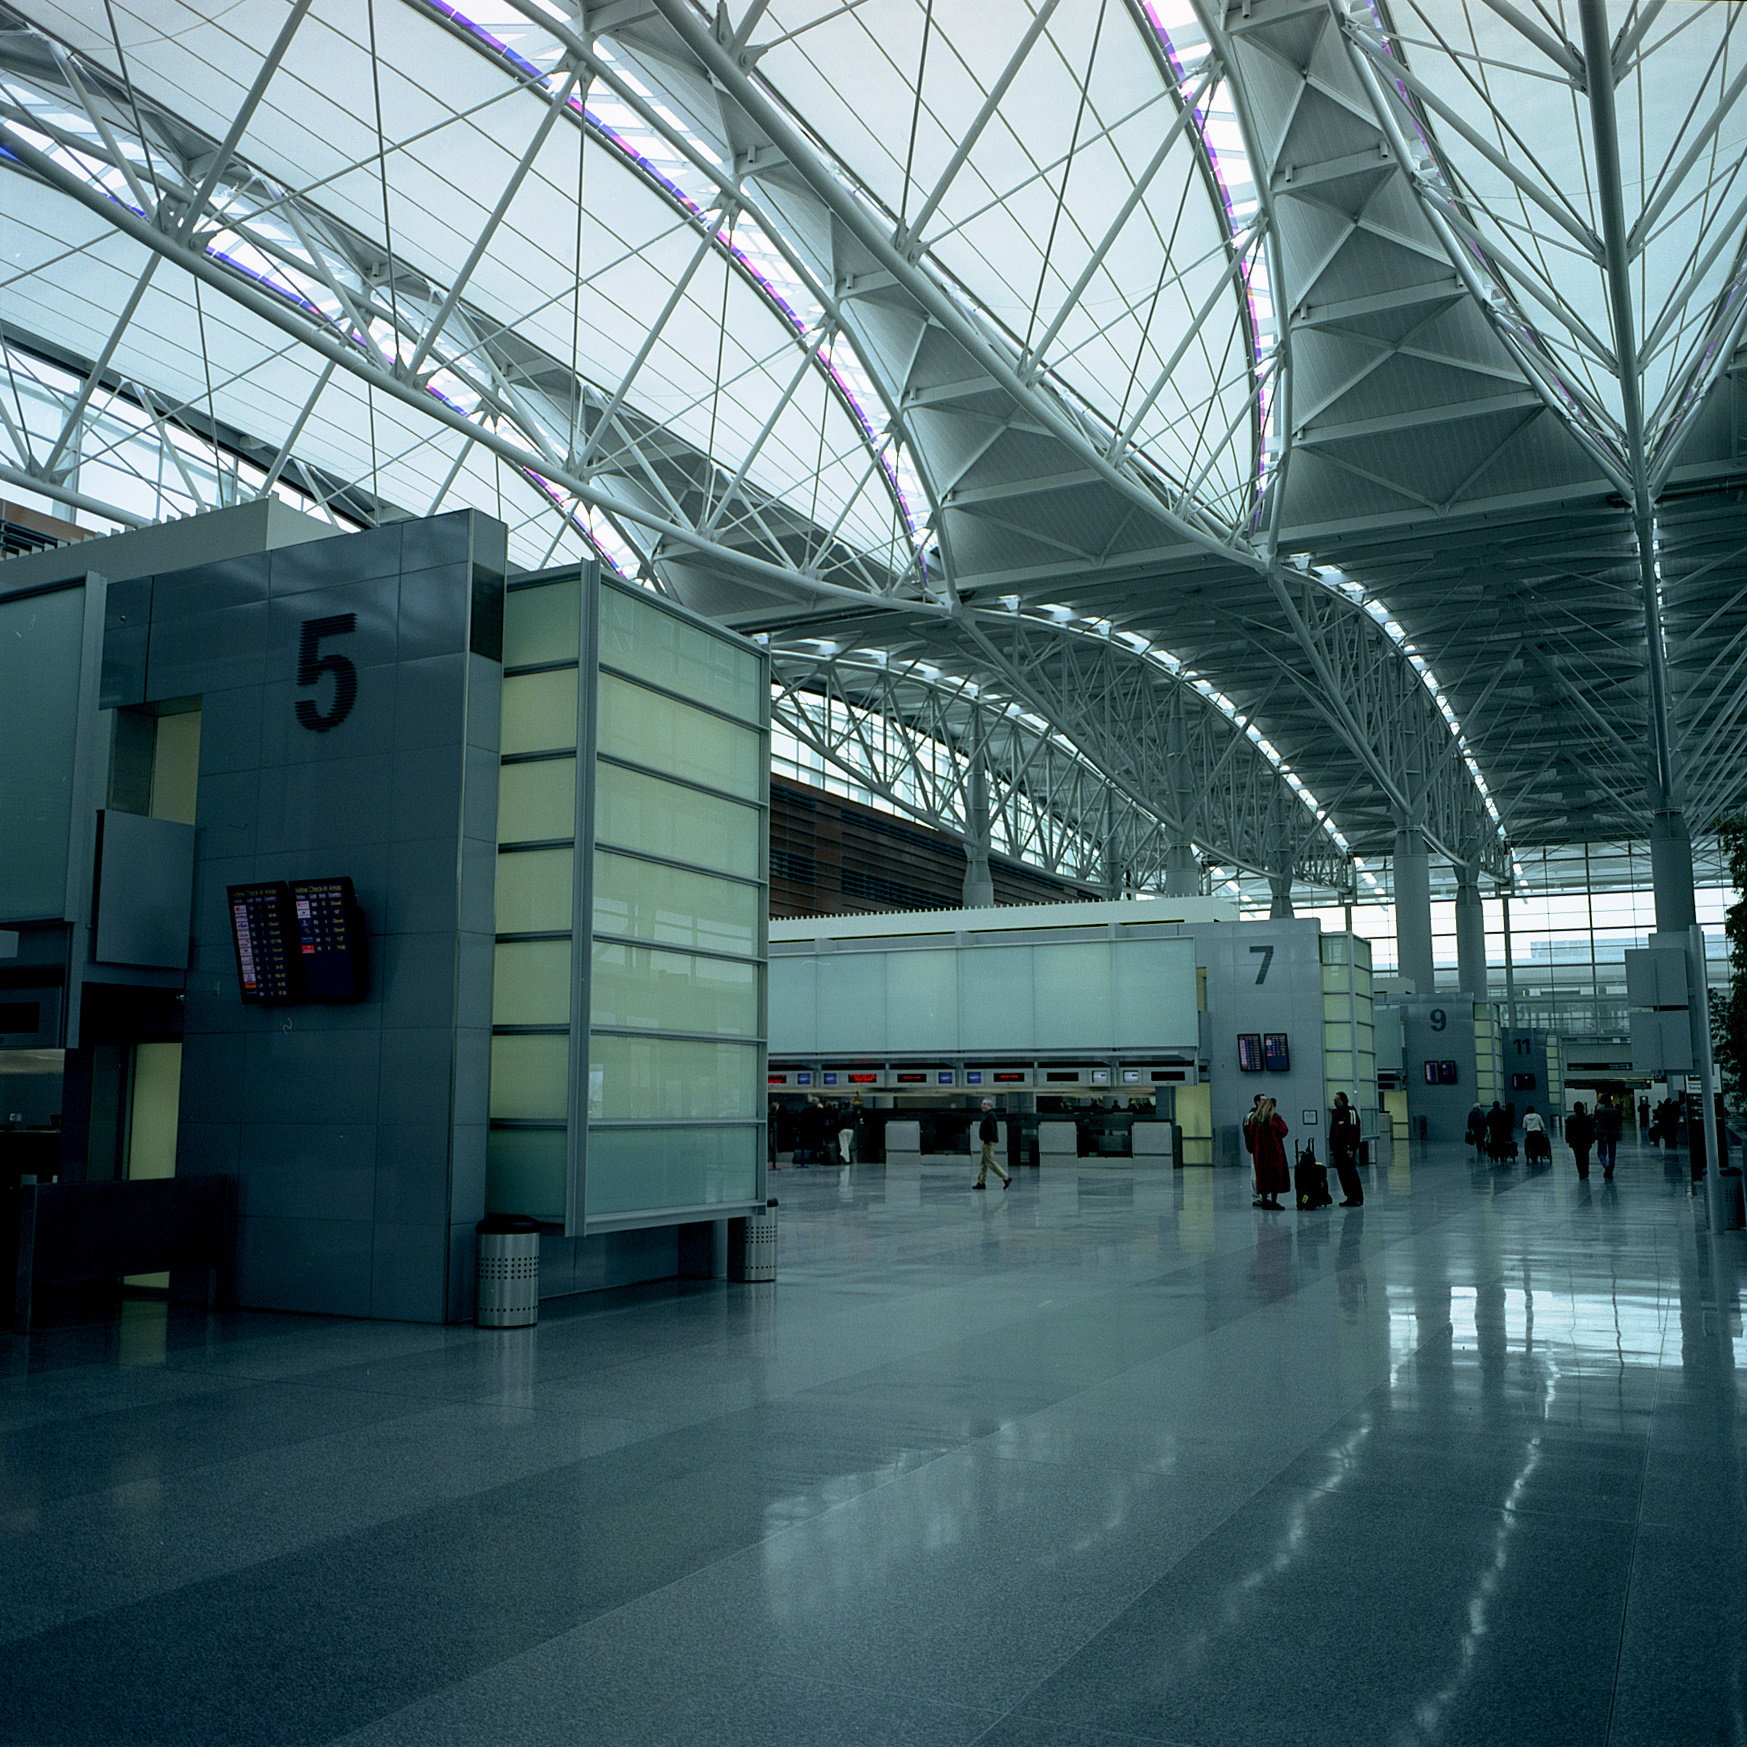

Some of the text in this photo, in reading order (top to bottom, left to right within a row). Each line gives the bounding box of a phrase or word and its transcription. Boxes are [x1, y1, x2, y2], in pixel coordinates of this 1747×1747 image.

[294, 612, 358, 733] 5
[1249, 945, 1274, 985] 7
[1430, 1008, 1447, 1032] 9
[1513, 1038, 1531, 1055] 11
